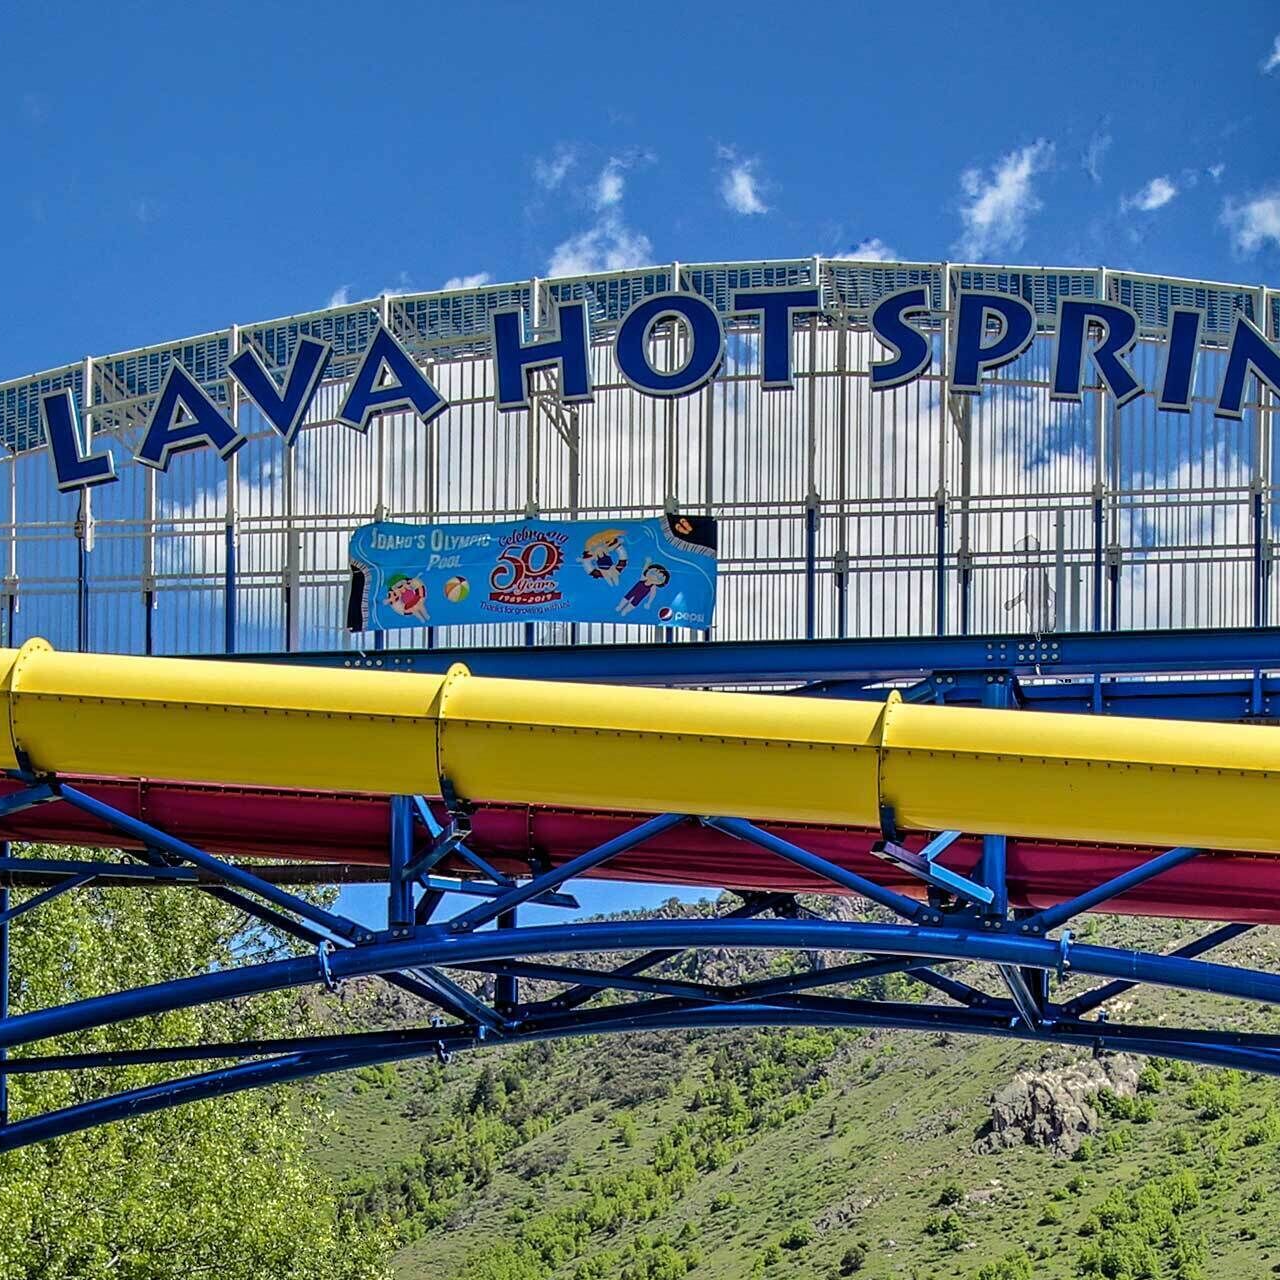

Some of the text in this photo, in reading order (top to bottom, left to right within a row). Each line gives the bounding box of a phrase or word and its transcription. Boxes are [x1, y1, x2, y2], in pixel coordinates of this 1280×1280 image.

[40, 324, 449, 492] LAVA
[489, 285, 822, 411] HOT
[489, 541, 559, 593] 50
[674, 611, 705, 622] pepsi
